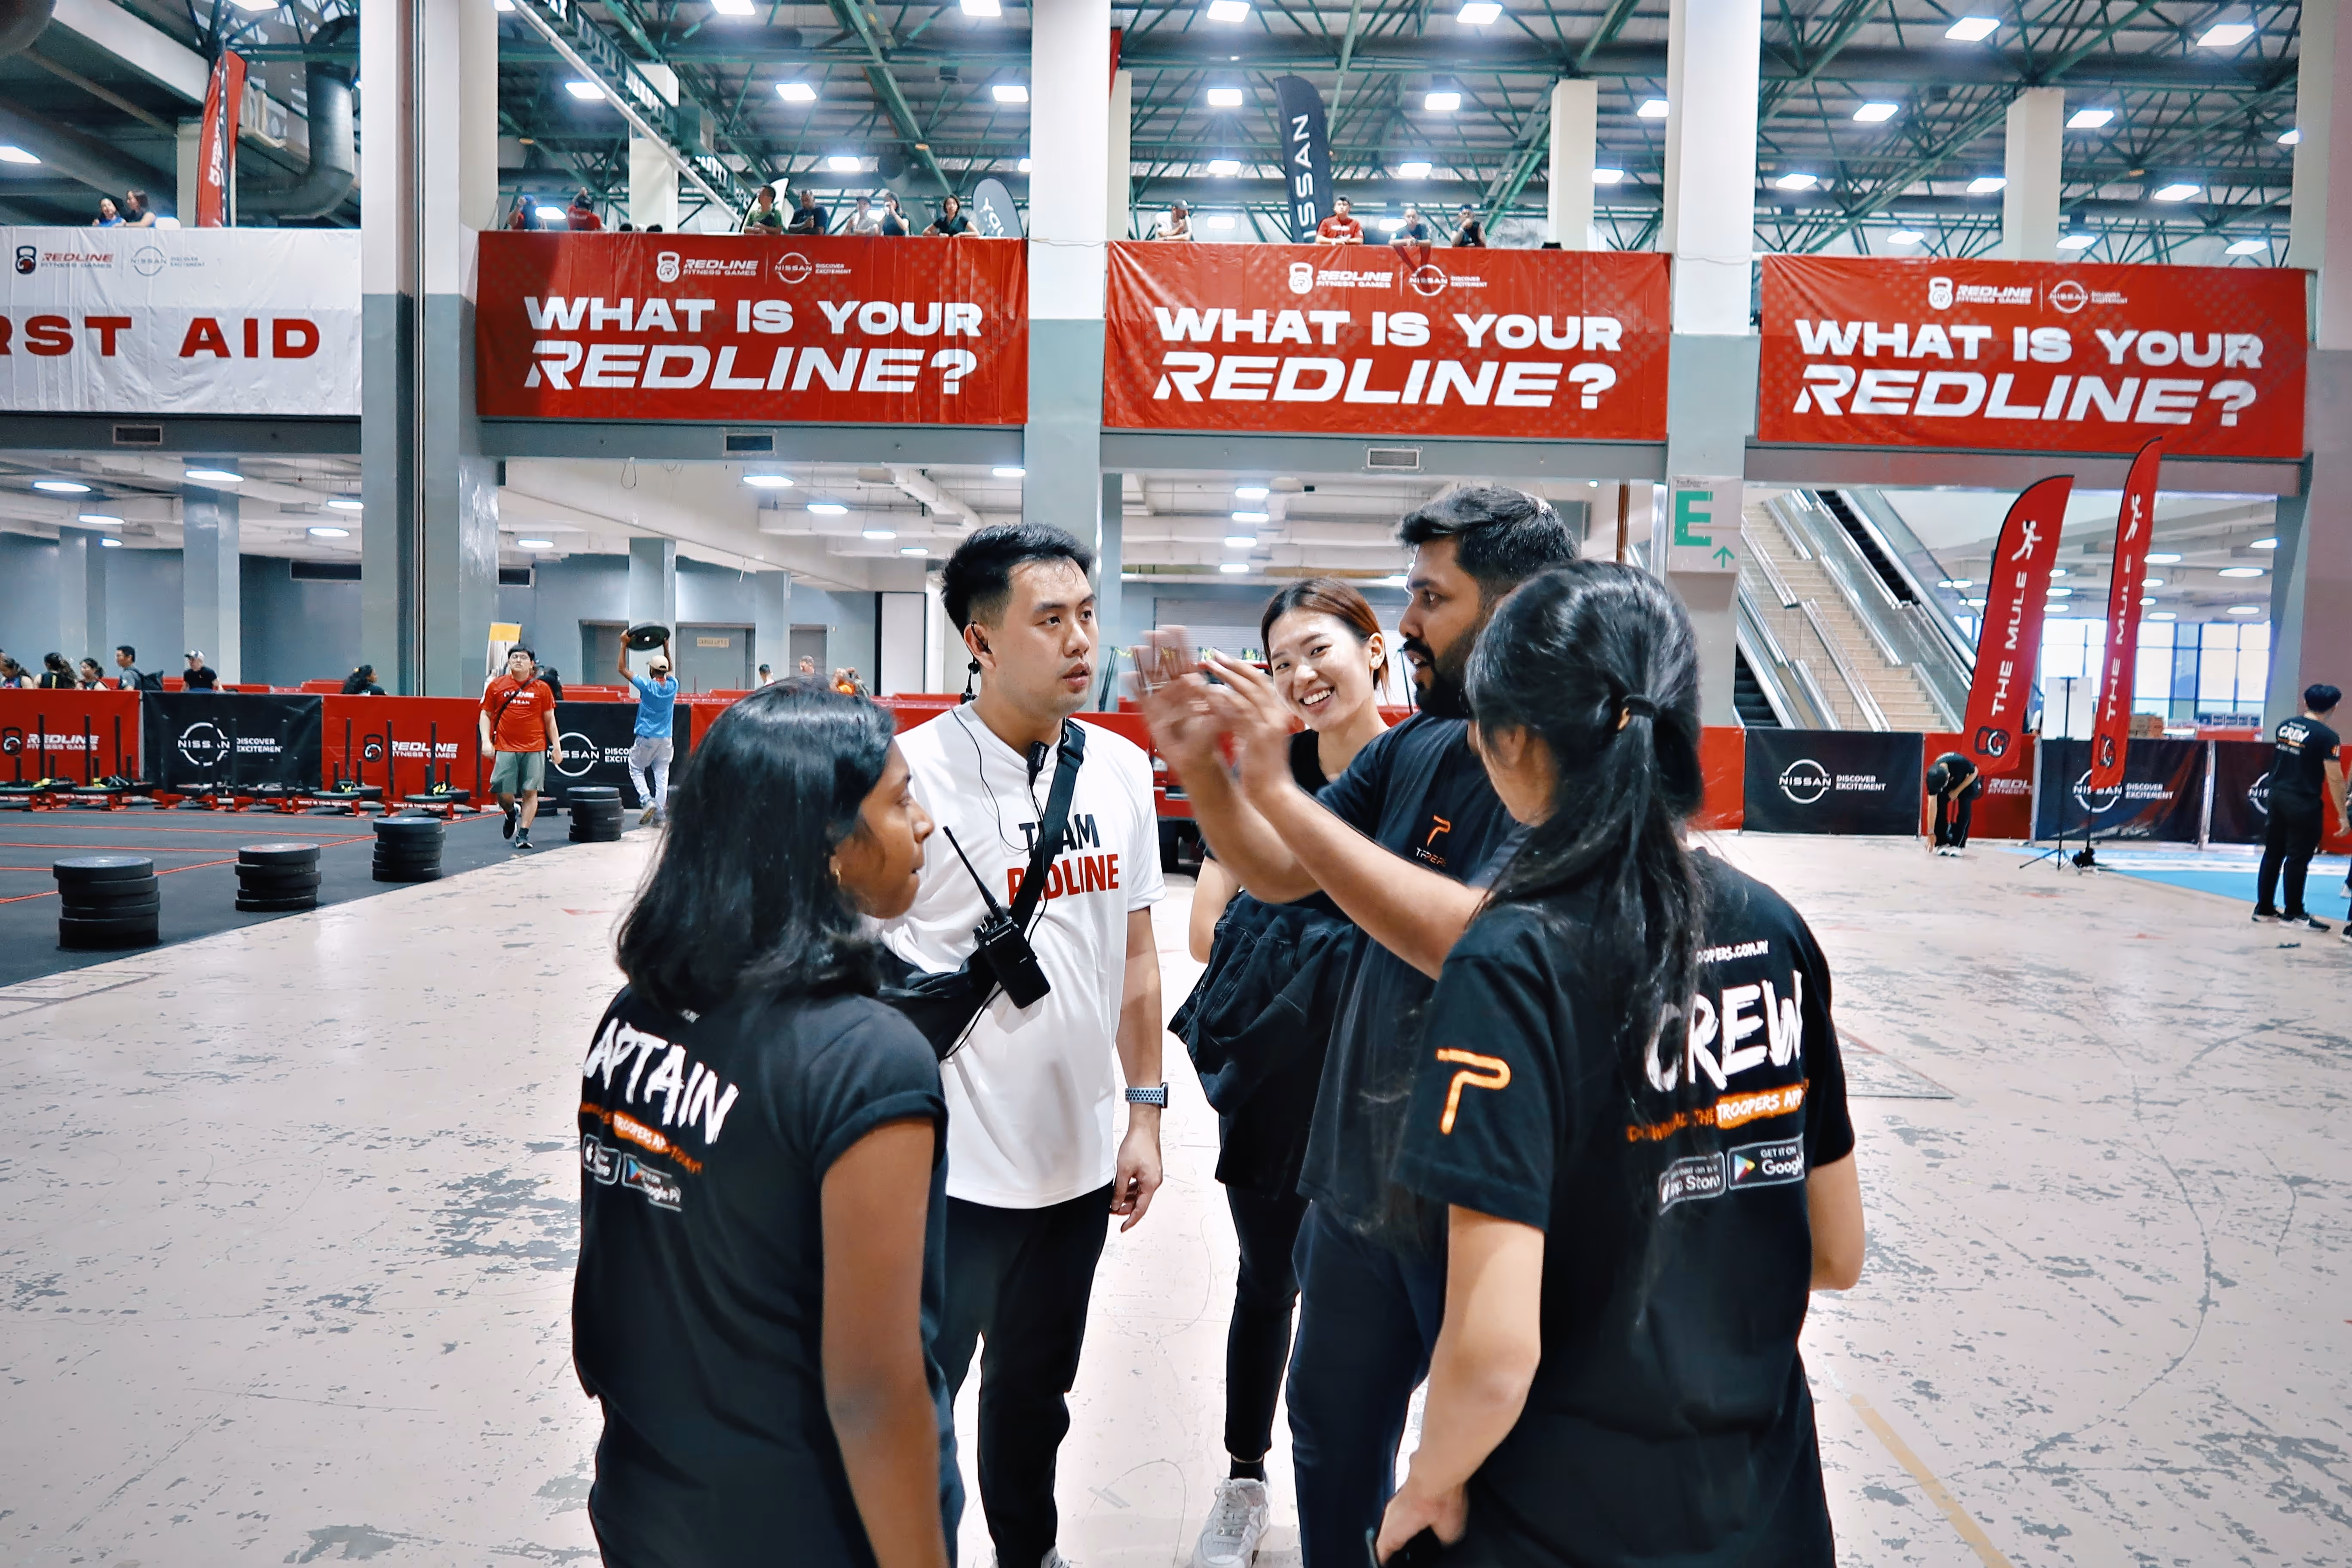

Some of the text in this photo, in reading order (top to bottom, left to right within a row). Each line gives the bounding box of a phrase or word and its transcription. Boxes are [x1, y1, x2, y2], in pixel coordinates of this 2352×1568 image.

[1292, 113, 1317, 239] ISSAN
[42, 253, 114, 262] REDLINE
[684, 259, 759, 270] REDLINE
[775, 264, 812, 272] NISSAN
[1317, 270, 1393, 282] REDLINE
[1956, 295, 1995, 303] FITNESS
[1957, 285, 2033, 297] REDLINE
[2049, 293, 2088, 301] NISSAN
[524, 297, 983, 337] WHAT IS YOUR
[179, 317, 320, 359] AID
[1153, 307, 1623, 352] WHAT IS YOUR
[1794, 319, 2263, 369] WHAT IS YOUR
[524, 340, 977, 395] REDLINE?
[1153, 352, 1617, 410] REDLINE?
[1792, 364, 2257, 426] REDLINE?
[1674, 490, 1713, 547] E
[1991, 571, 2028, 717] THE MULE
[2106, 657, 2121, 722] THE
[2279, 725, 2310, 743] CREW
[392, 740, 458, 752] REDLNE
[547, 750, 600, 759] NSSAN
[1779, 776, 1831, 787] NISSAN
[1836, 775, 1876, 783] DISCOVER
[1836, 783, 1886, 791] EXCITEMENT
[1989, 778, 2032, 790] REDL
[2126, 782, 2163, 791] DISCOVER
[2125, 791, 2174, 799] EXCITEMENT
[1018, 814, 1100, 859] TAM
[1007, 854, 1119, 906] RDLINE
[1696, 939, 1769, 965] OOPERS.COM.MY
[1645, 969, 1803, 1092] CREW
[584, 1017, 739, 1145] APTAIN
[1715, 1093, 1780, 1122] TROOPERS
[1760, 1145, 1797, 1158] GET IT ON
